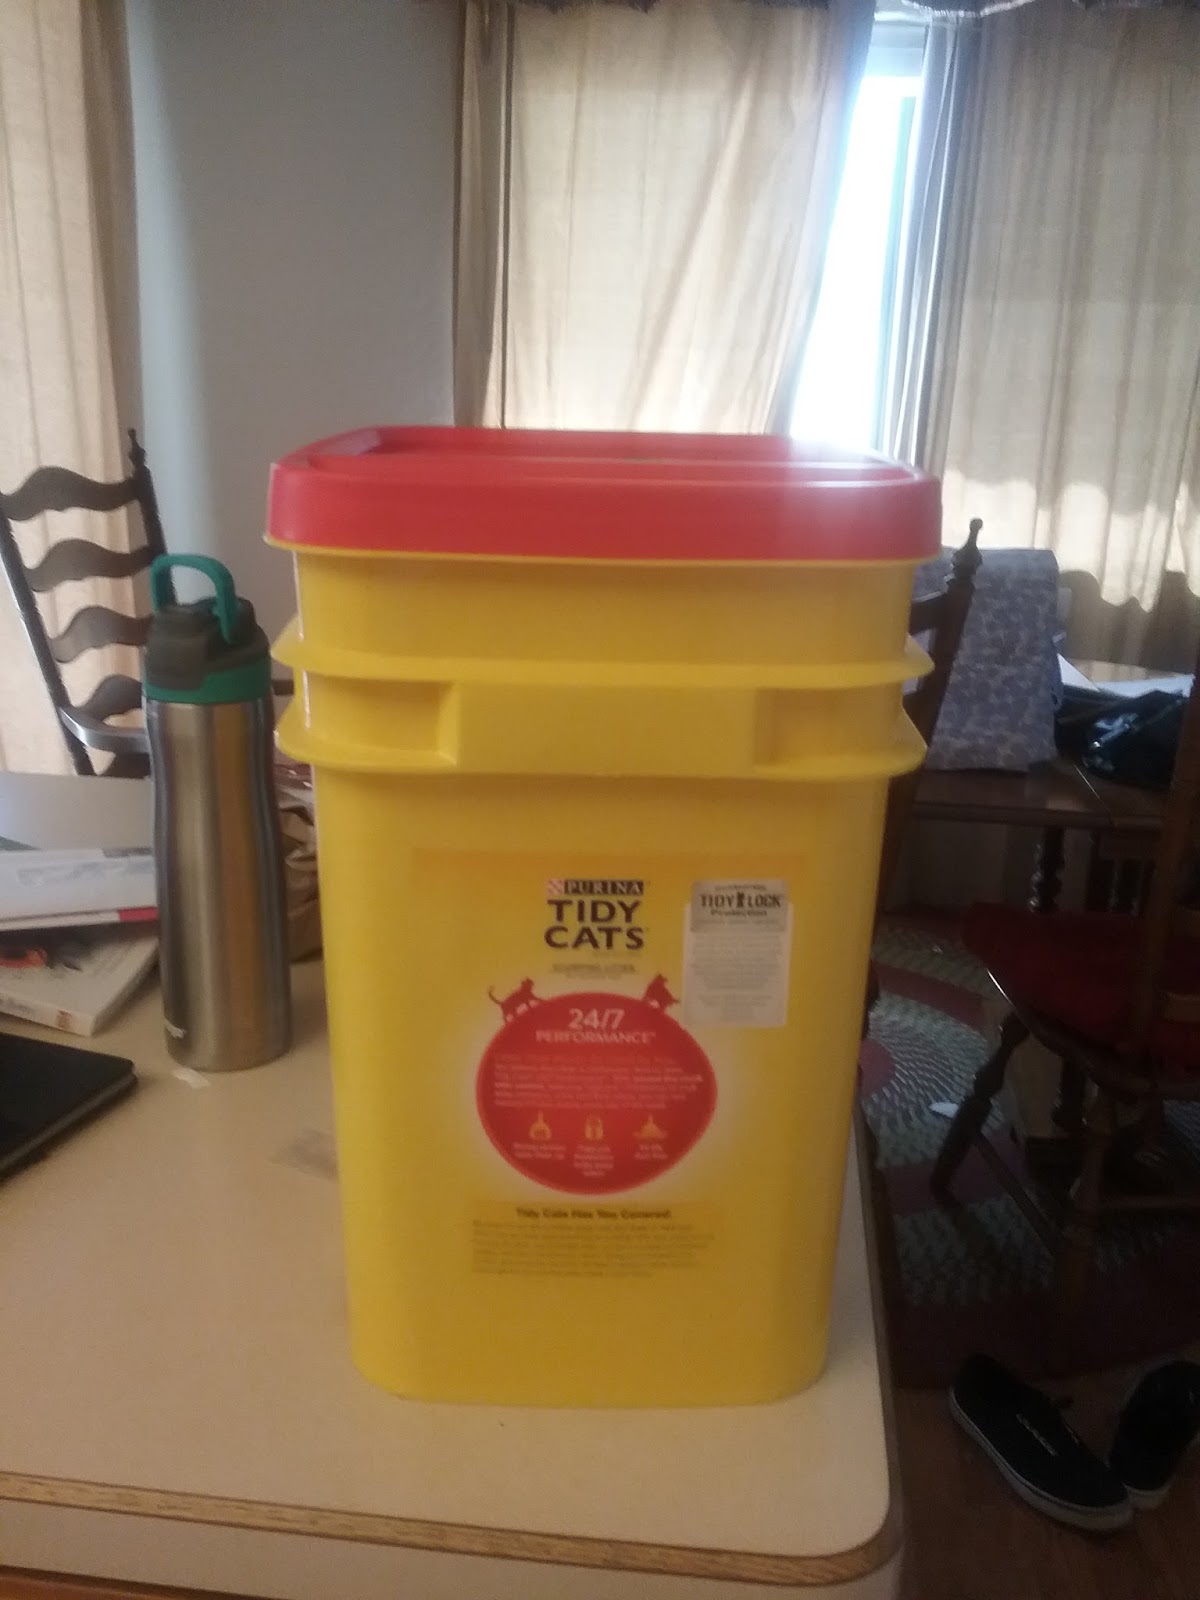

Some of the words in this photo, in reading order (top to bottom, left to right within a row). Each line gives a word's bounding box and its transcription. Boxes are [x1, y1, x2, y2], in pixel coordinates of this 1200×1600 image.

[565, 880, 645, 895] PURINA
[700, 893, 734, 908] TIDY
[748, 893, 781, 908] LOCK
[547, 899, 642, 923] TIDY
[544, 926, 645, 950] CATS
[568, 1008, 625, 1029] 24/7
[535, 1031, 650, 1044] PERFORMANCE
